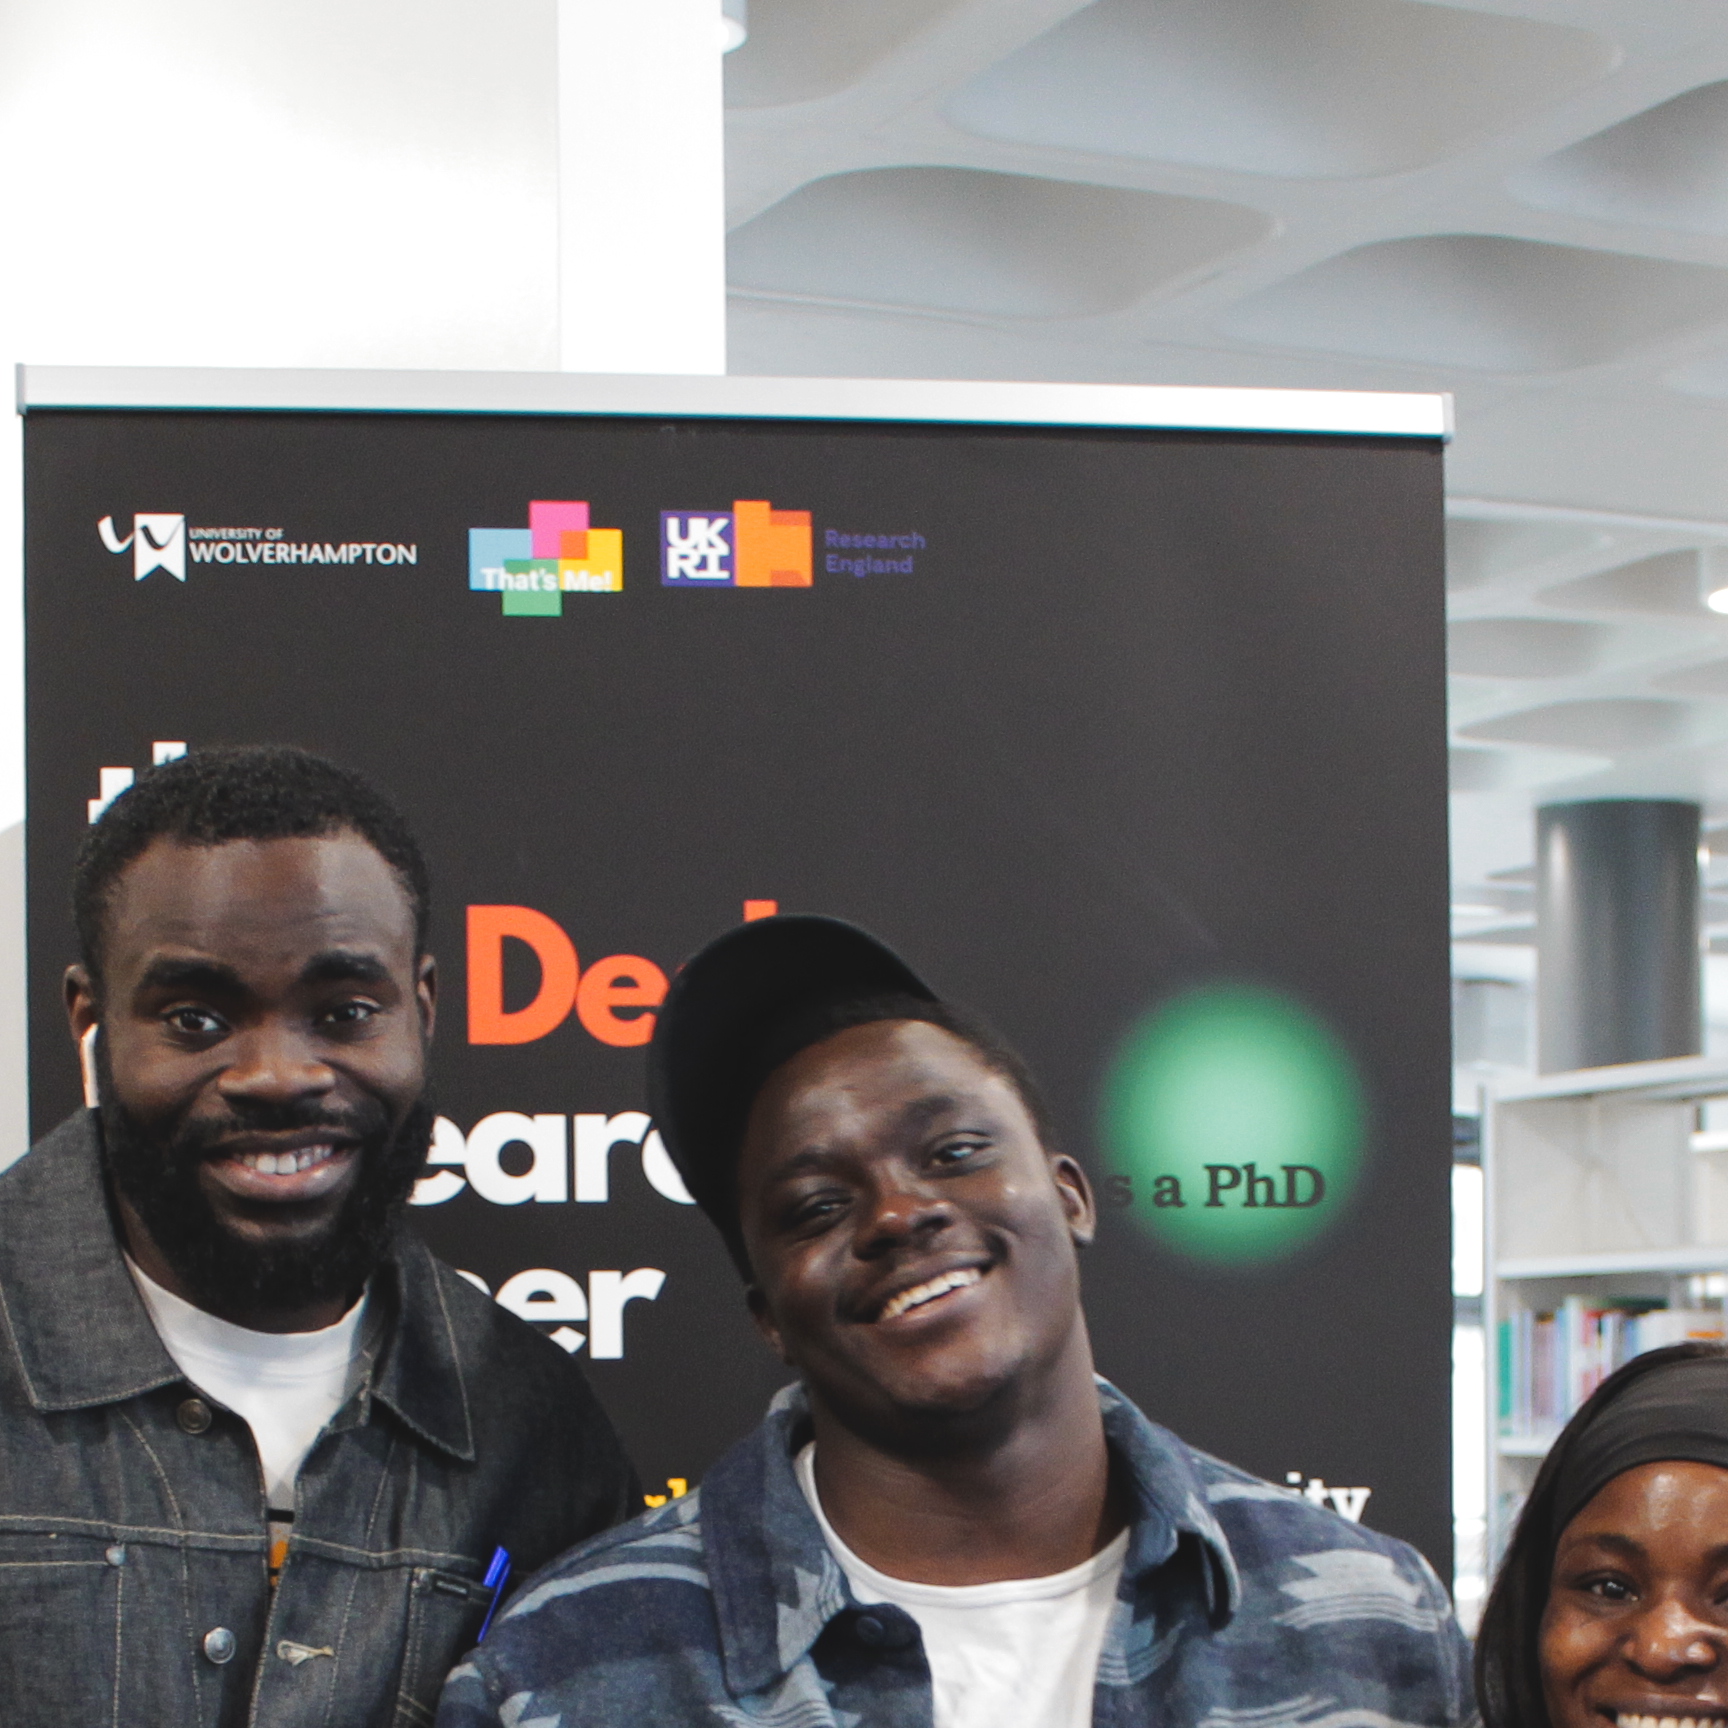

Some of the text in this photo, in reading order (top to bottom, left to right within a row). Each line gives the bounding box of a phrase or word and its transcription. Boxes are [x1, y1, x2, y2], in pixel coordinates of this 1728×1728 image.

[188, 527, 284, 540] UNIVERSITY OF
[666, 516, 730, 550] UK
[824, 529, 926, 550] Research
[188, 541, 418, 565] WOLVERHAMPTON
[666, 548, 730, 580] RI
[825, 554, 914, 577] England
[481, 567, 612, 592] That's Me!
[1152, 1174, 1187, 1208] a
[1202, 1161, 1327, 1208] PhD
